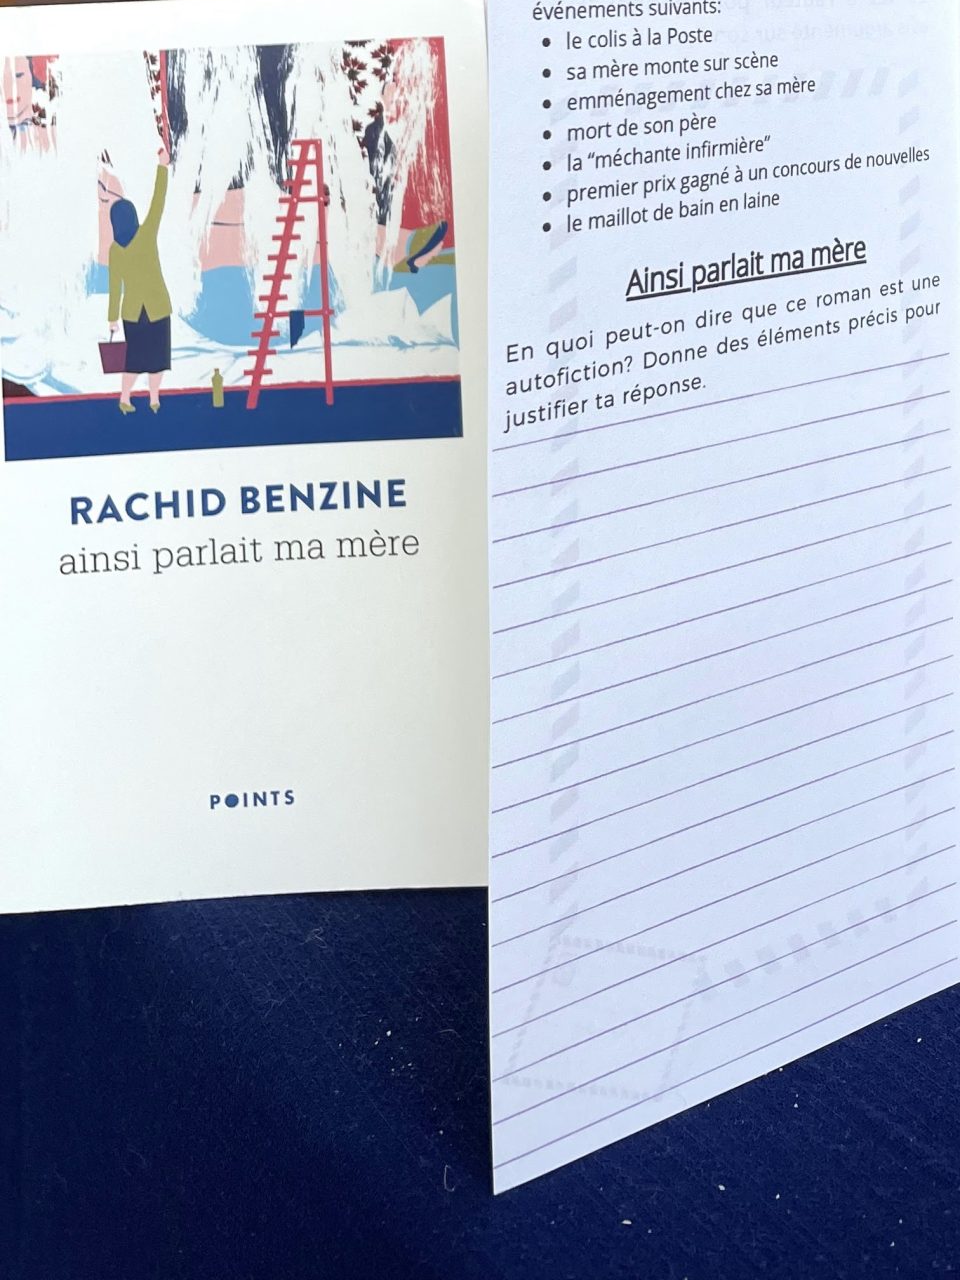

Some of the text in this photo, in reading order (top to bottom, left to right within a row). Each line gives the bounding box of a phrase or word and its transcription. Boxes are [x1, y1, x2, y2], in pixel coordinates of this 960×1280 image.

[532, 0, 644, 21] événements
[566, 26, 713, 50] le colis à la Poste
[566, 52, 779, 81] sa mère monte sur scène
[566, 76, 816, 111] emménagement chez sa mère
[567, 113, 717, 142] mort de son père
[566, 154, 583, 173] la
[567, 146, 930, 208] premier prix gagné à un concours de nouvelles
[566, 191, 781, 233] le maillot de bain en laine
[626, 237, 867, 297] Ainsi parlait ma mère
[506, 273, 941, 364] En quoi peut-on dire que ce roman est une
[505, 299, 941, 397] autofiction? Donne des éléments précis pour
[503, 374, 707, 434] justifier ta réponse.
[70, 478, 408, 525] RACHID BENZINE
[59, 528, 421, 576] ainsi parlait ma mère
